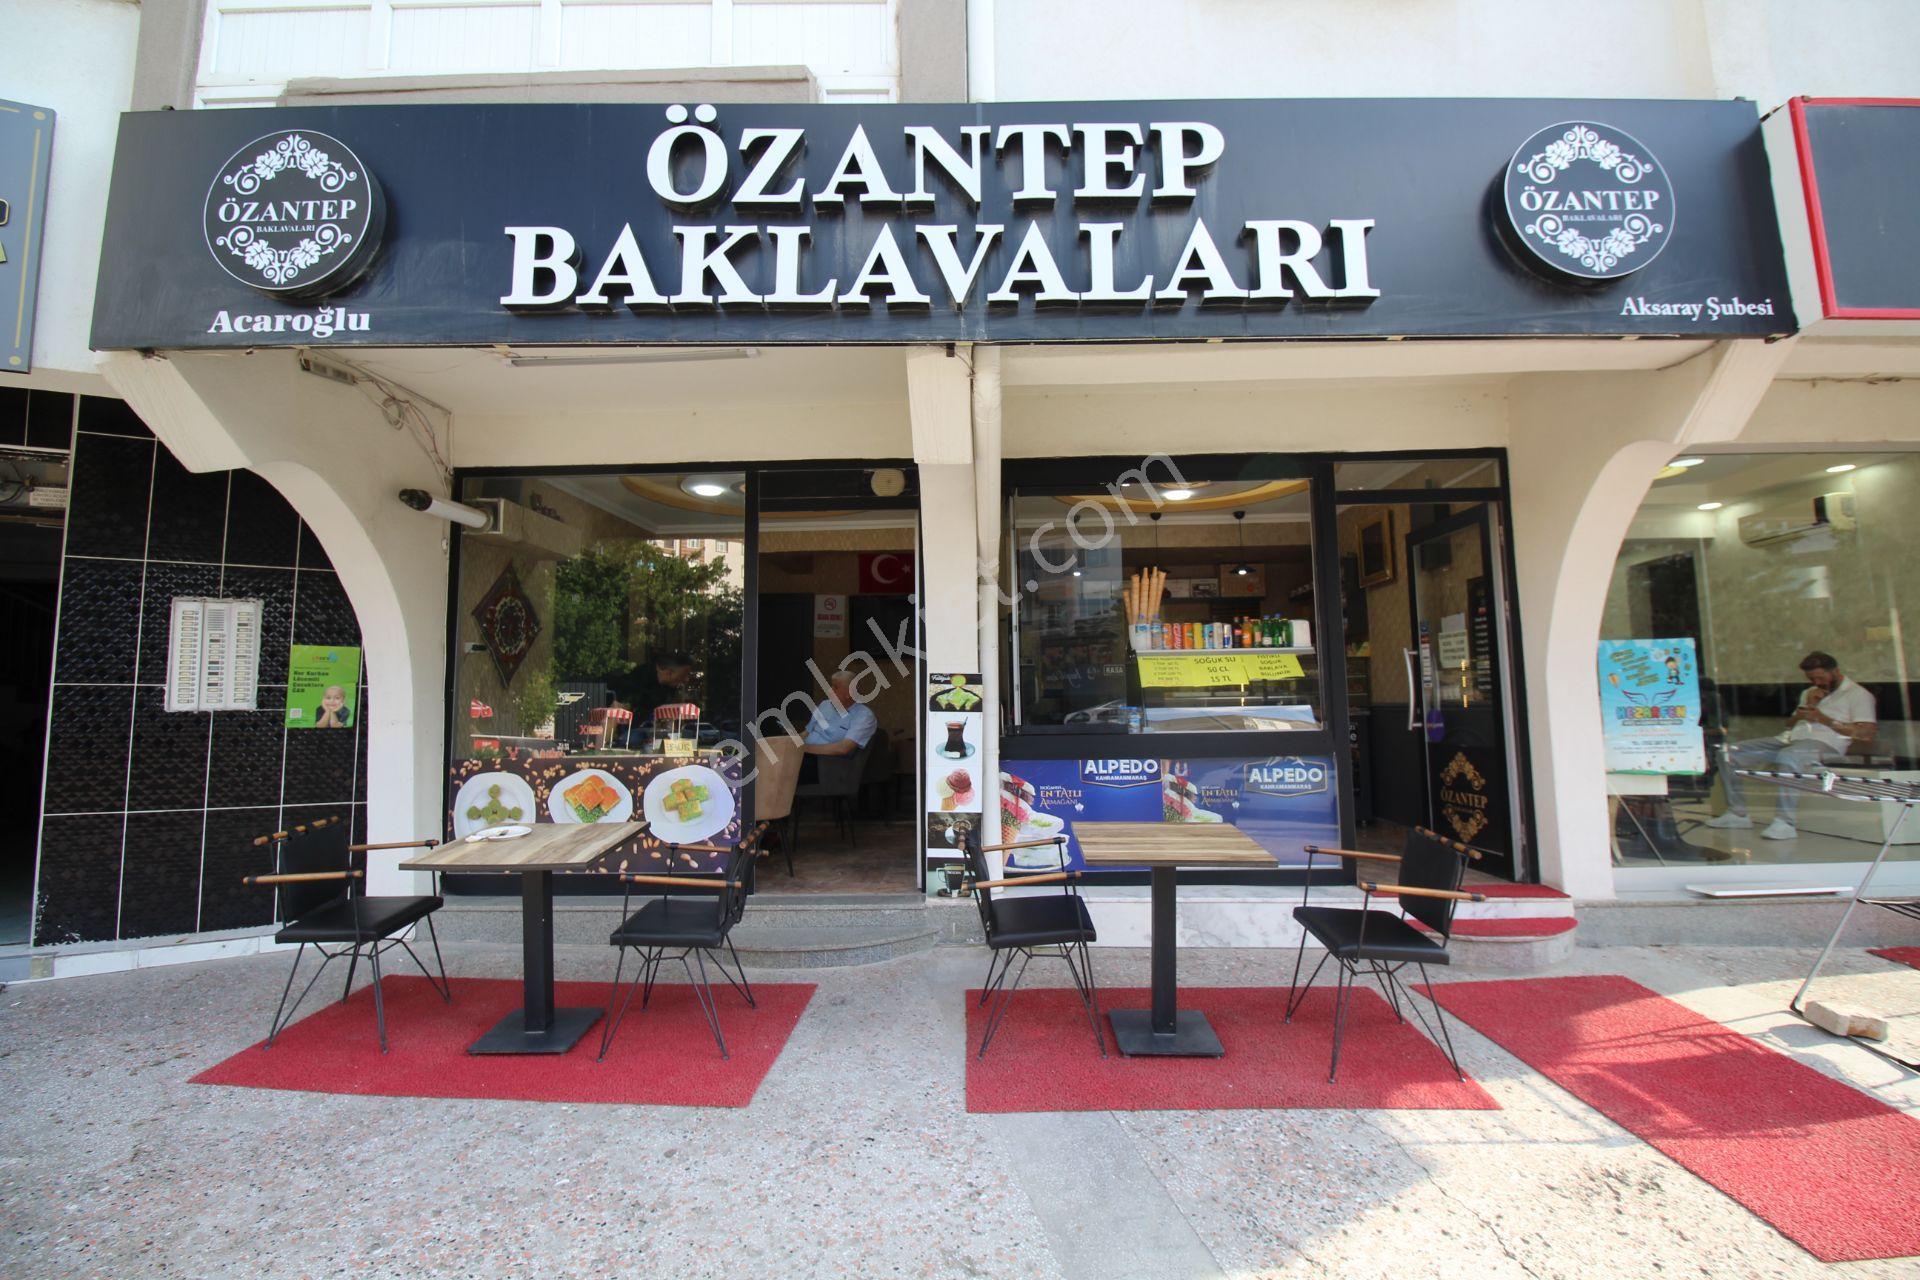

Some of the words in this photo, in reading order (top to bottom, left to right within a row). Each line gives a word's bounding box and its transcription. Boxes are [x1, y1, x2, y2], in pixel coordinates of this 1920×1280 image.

[647, 104, 1225, 204] ÖZANTEP
[218, 197, 357, 223] ÖZANTEP
[1520, 185, 1660, 212] ÖZANTEP
[256, 224, 316, 233] BAKLAVALARI
[500, 218, 1381, 307] BAKLAVALARI
[1619, 296, 1703, 321] Aksaray
[1705, 296, 1775, 321] Şubesi
[207, 306, 371, 338] Acaroğlu
[1616, 706, 1687, 720] HEZARFEN
[1084, 759, 1159, 774] ALPEDO
[1249, 767, 1323, 783] ALPEDO
